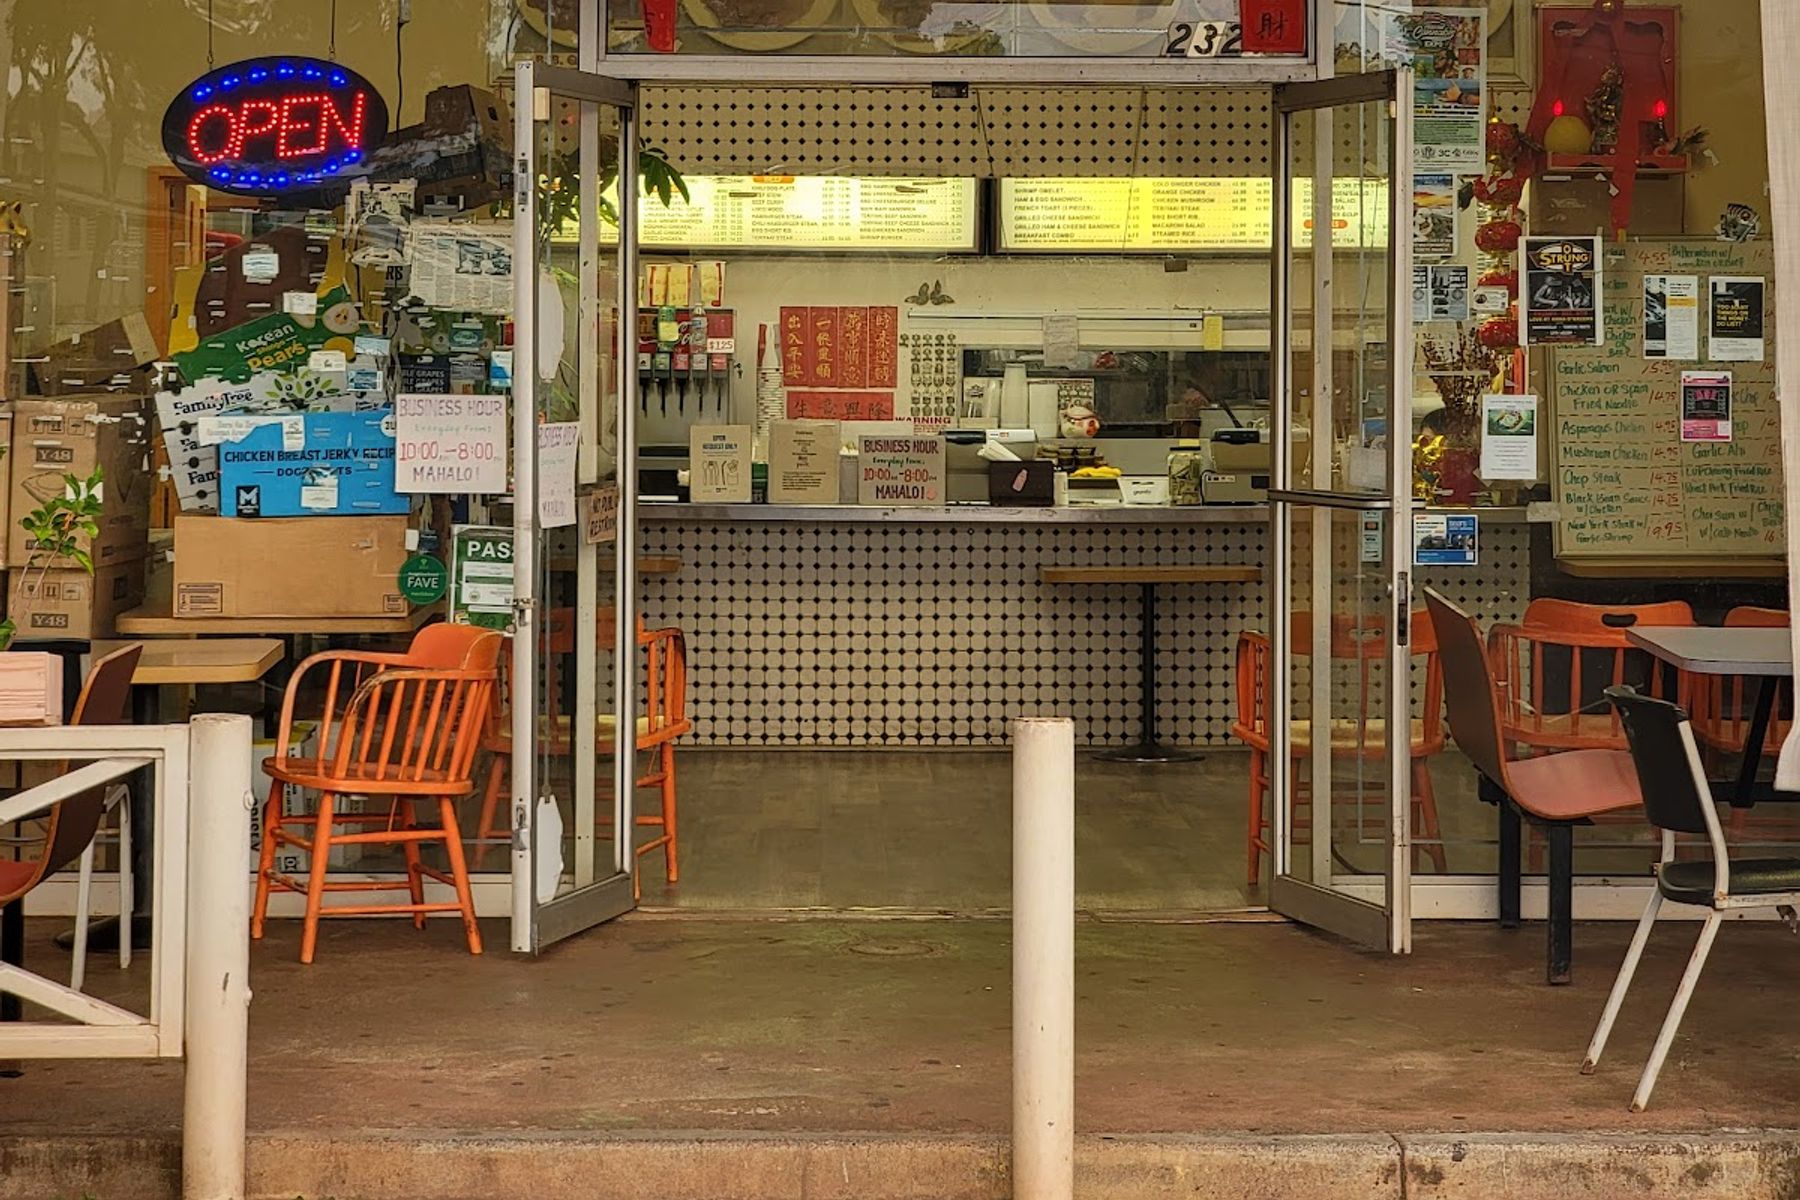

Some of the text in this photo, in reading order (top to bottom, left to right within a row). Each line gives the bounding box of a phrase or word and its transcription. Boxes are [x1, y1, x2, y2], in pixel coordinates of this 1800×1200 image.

[1166, 22, 1242, 54] 232
[187, 91, 366, 163] OPEN
[1539, 252, 1589, 266] STRUNG
[247, 341, 306, 369] Pears
[785, 314, 804, 380] 出入平安
[399, 399, 503, 417] BUSINESS HOUR
[37, 448, 73, 461] Y48
[224, 447, 396, 463] CHICKEN BREAST JERKY RECIP
[863, 439, 939, 455] BUSINESS HOUR
[412, 465, 481, 482] MAHALO!
[875, 484, 925, 500] MAHALO!
[467, 541, 514, 559] PAS
[407, 576, 439, 589] FAVE
[32, 615, 68, 627] Y48
